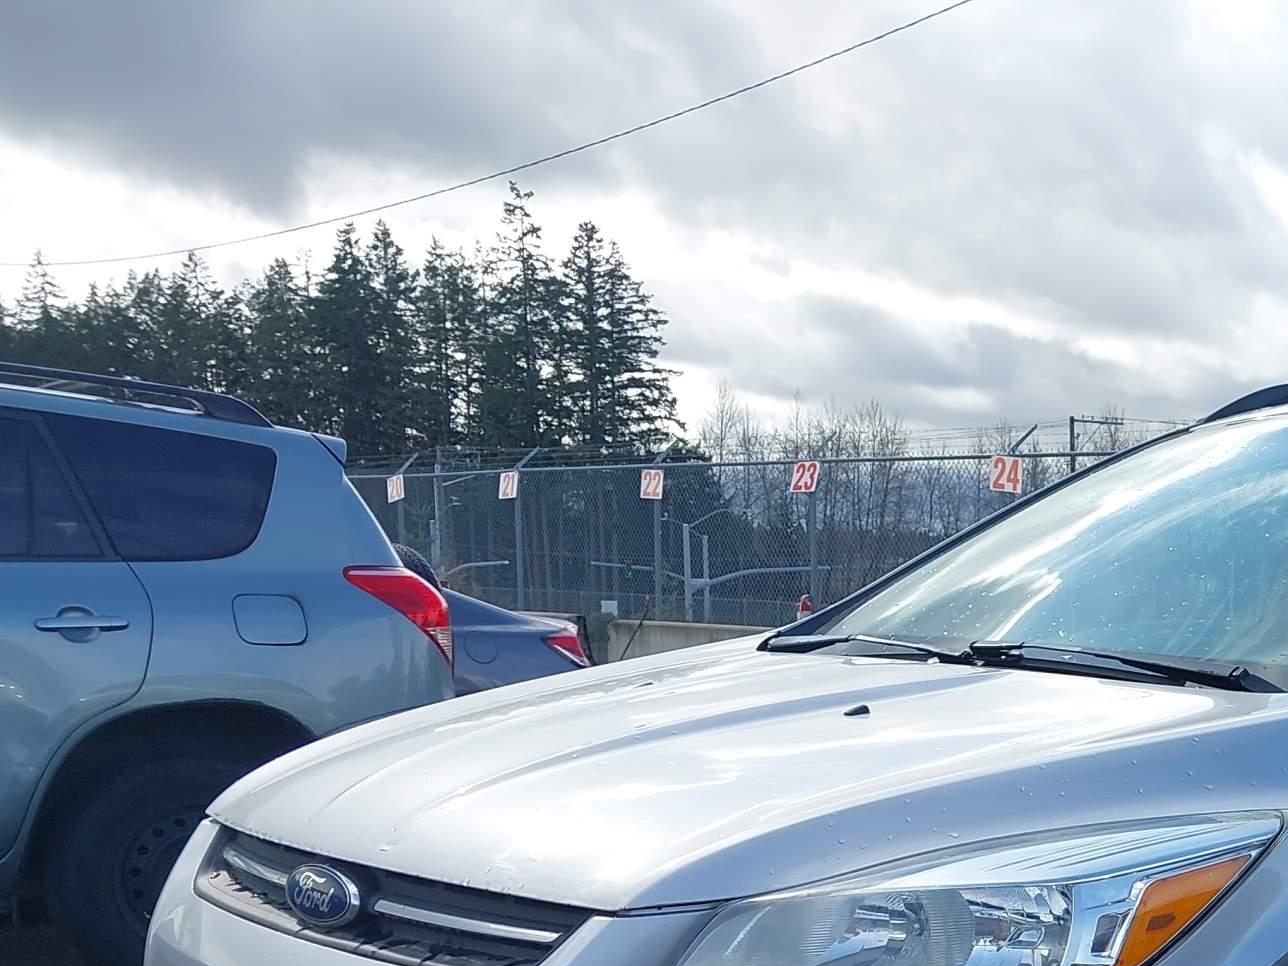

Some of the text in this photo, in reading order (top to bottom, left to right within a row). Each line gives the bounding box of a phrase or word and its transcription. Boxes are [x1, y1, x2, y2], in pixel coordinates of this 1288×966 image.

[502, 473, 515, 497] 21
[643, 472, 661, 497] 22
[793, 463, 817, 490] 23
[992, 457, 1020, 490] 24
[389, 476, 403, 501] 20
[294, 871, 334, 913] Ford
